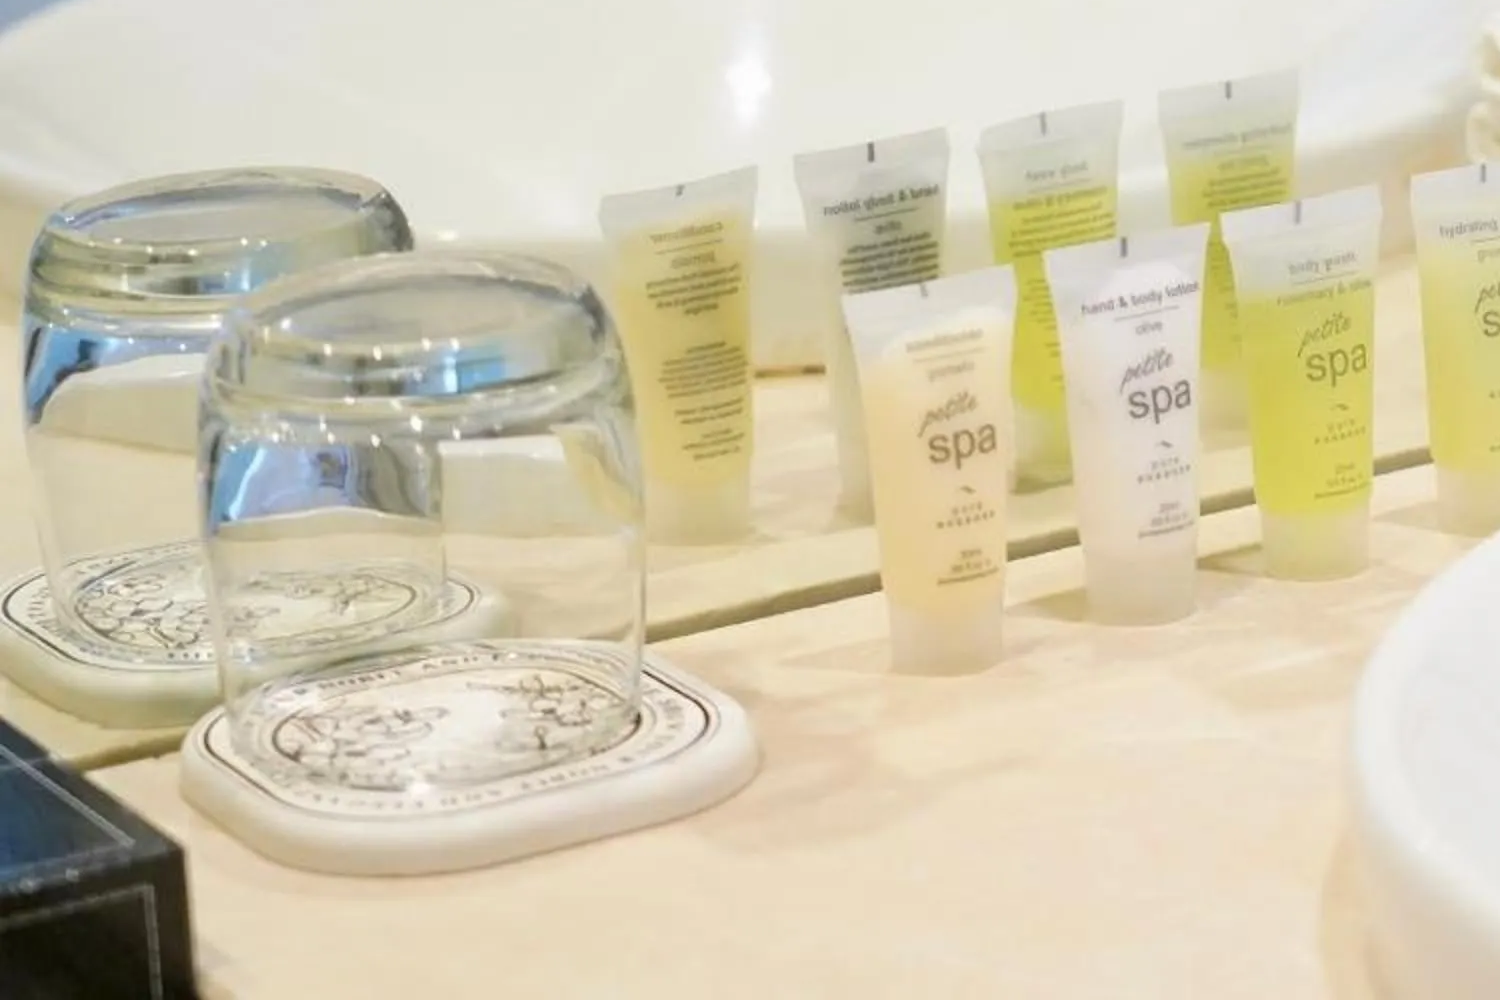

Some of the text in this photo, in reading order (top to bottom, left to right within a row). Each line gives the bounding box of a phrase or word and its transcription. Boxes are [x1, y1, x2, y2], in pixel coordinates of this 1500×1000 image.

[1438, 217, 1498, 240] hydrating
[1080, 298, 1115, 317] hand
[1118, 294, 1129, 309] &
[1131, 288, 1163, 307] body
[1305, 343, 1368, 389] spa
[1128, 378, 1192, 425] spa
[927, 422, 997, 471] spa
